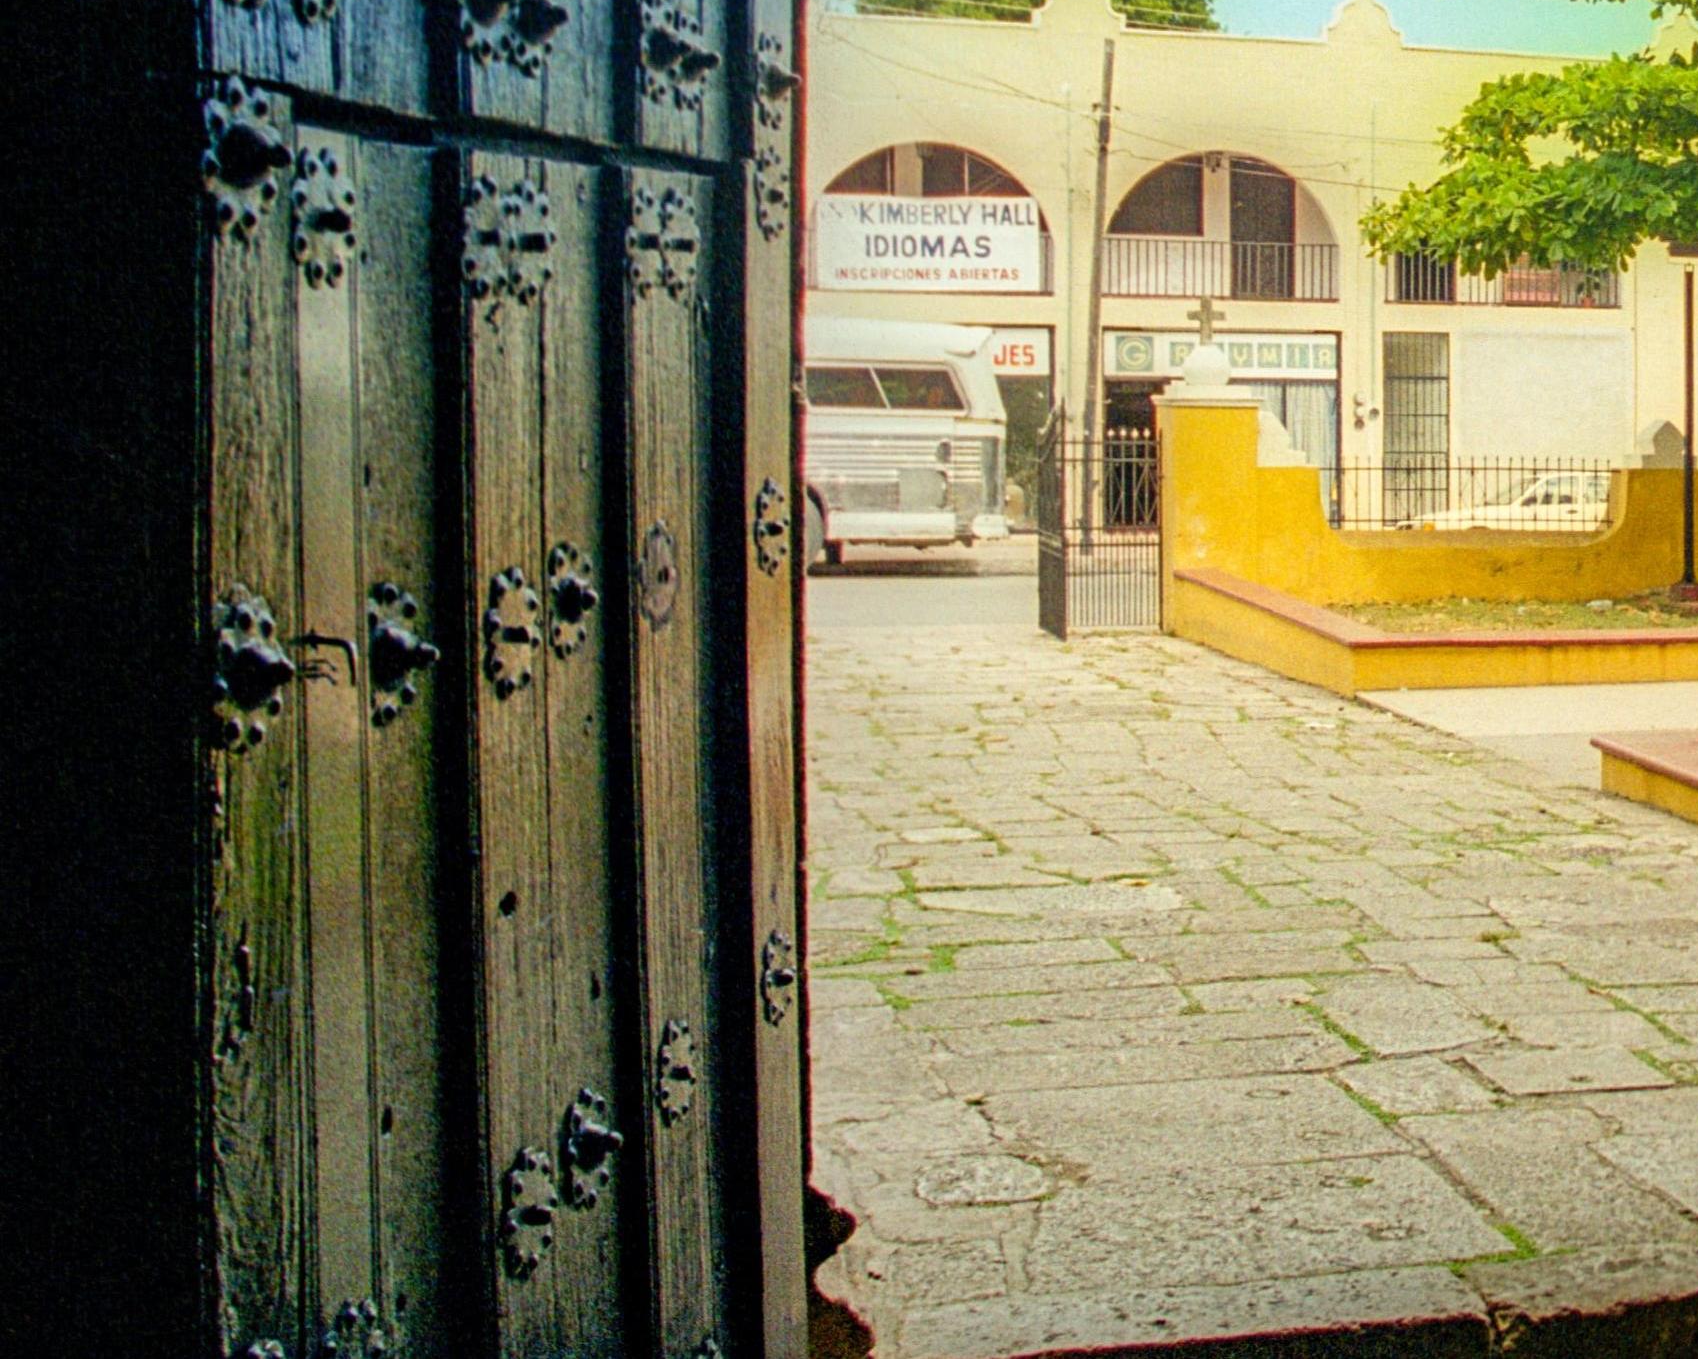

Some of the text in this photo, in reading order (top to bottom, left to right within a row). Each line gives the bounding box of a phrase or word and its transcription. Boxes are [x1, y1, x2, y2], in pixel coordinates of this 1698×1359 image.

[859, 201, 1035, 226] KIMBERLY HALL
[865, 234, 992, 258] IDIOMAS
[835, 267, 1020, 281] INSCRIPCIONES ABIERTAS
